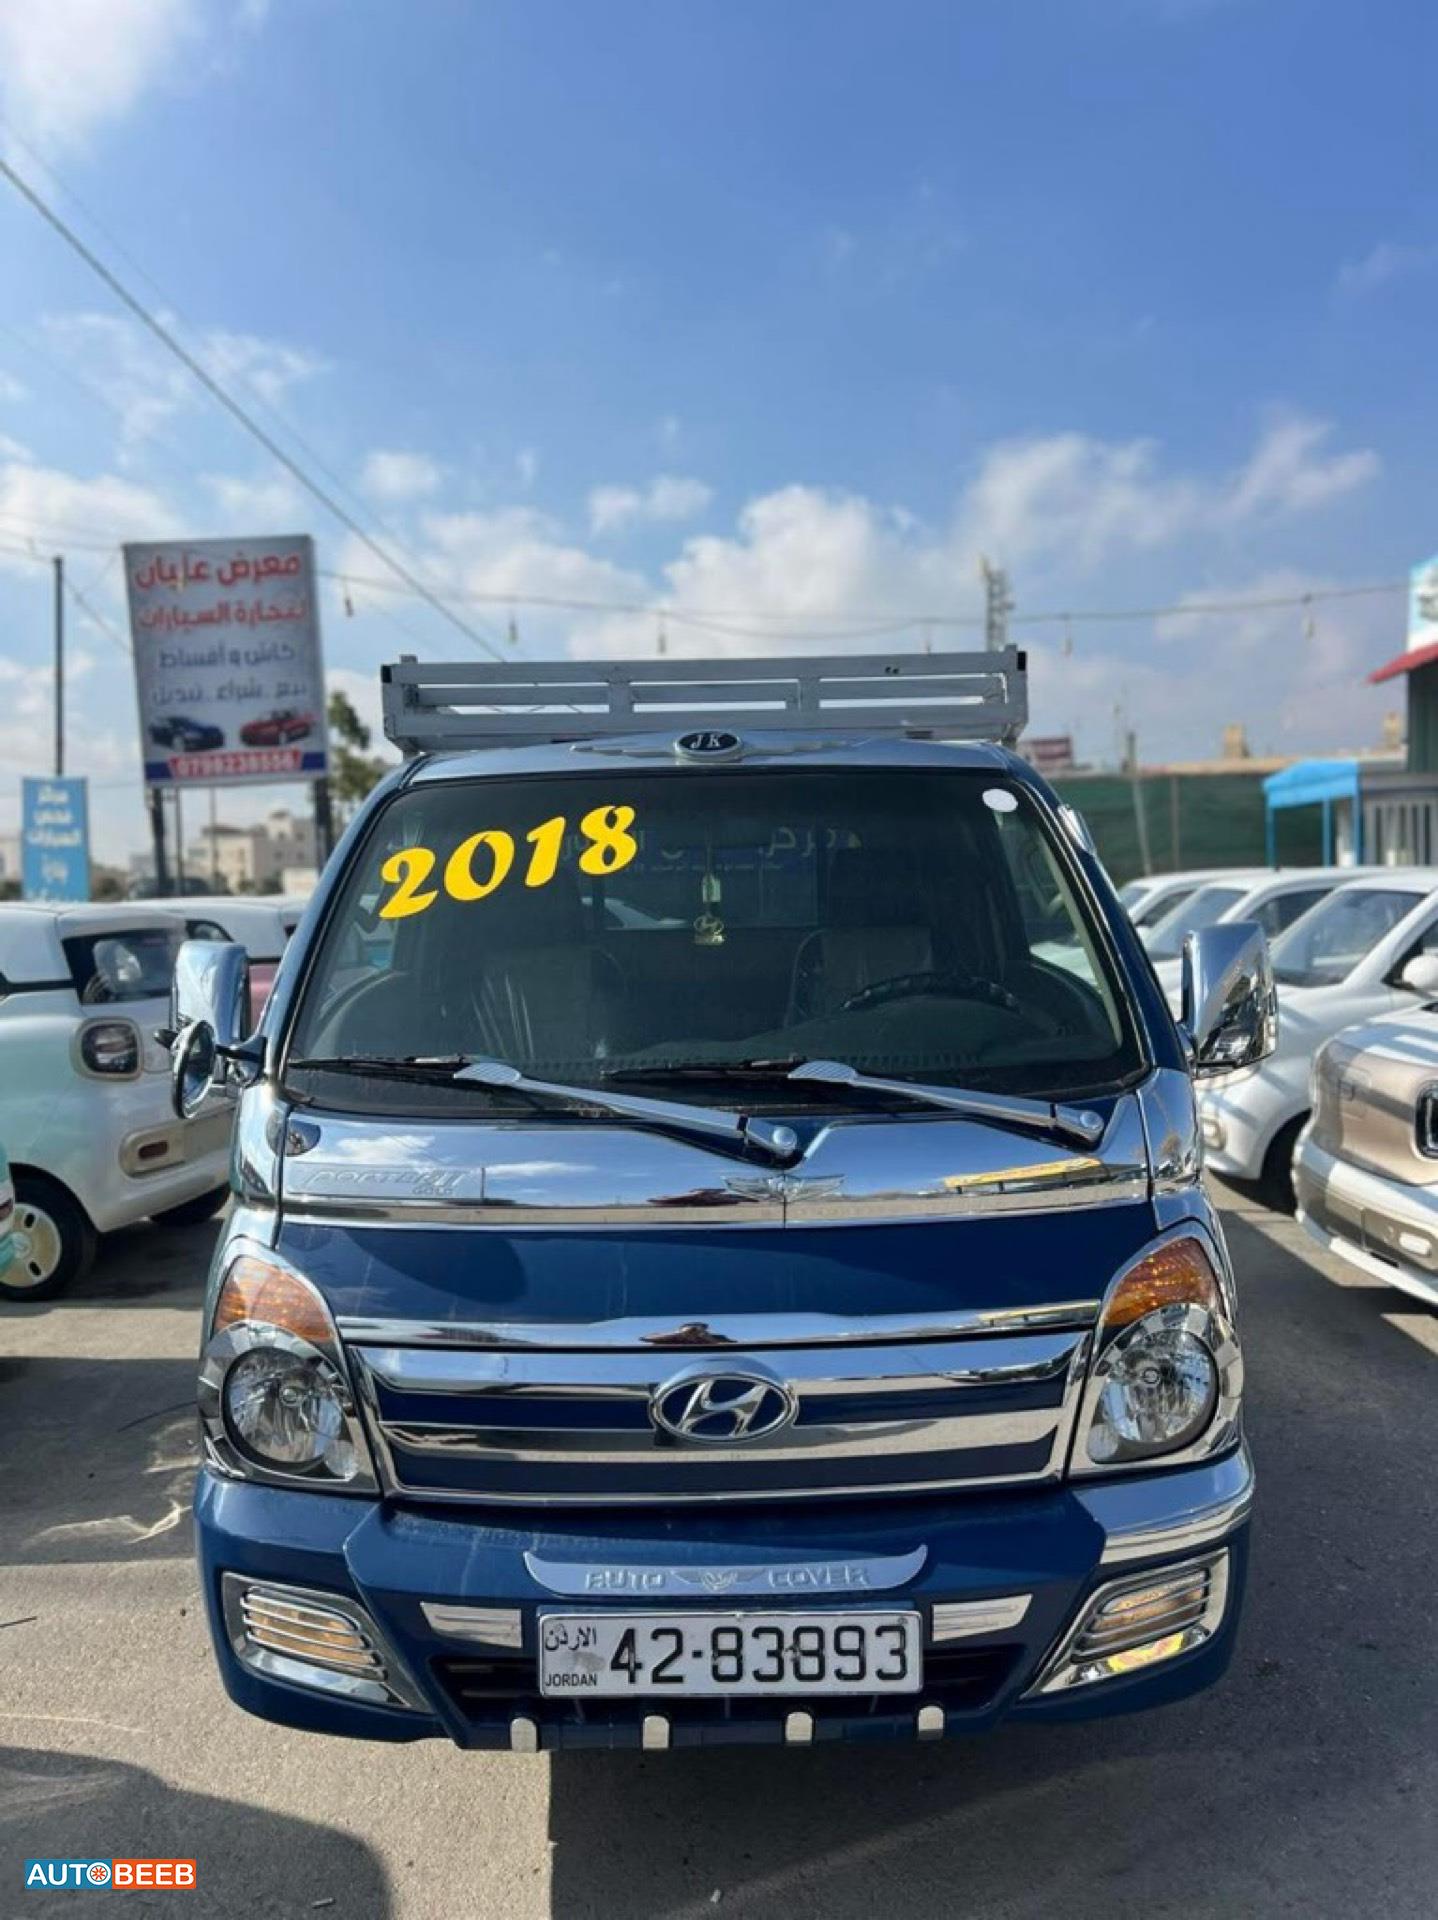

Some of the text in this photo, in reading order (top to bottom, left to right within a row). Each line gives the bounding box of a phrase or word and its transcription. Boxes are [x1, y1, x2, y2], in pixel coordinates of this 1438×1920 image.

[217, 552, 300, 587] معرض
[138, 599, 231, 634] السيارات
[378, 805, 638, 919] 2018
[585, 1565, 870, 1590] AUTO COVER
[610, 1625, 907, 1685] 42-83893
[545, 1673, 597, 1687] JORDAN
